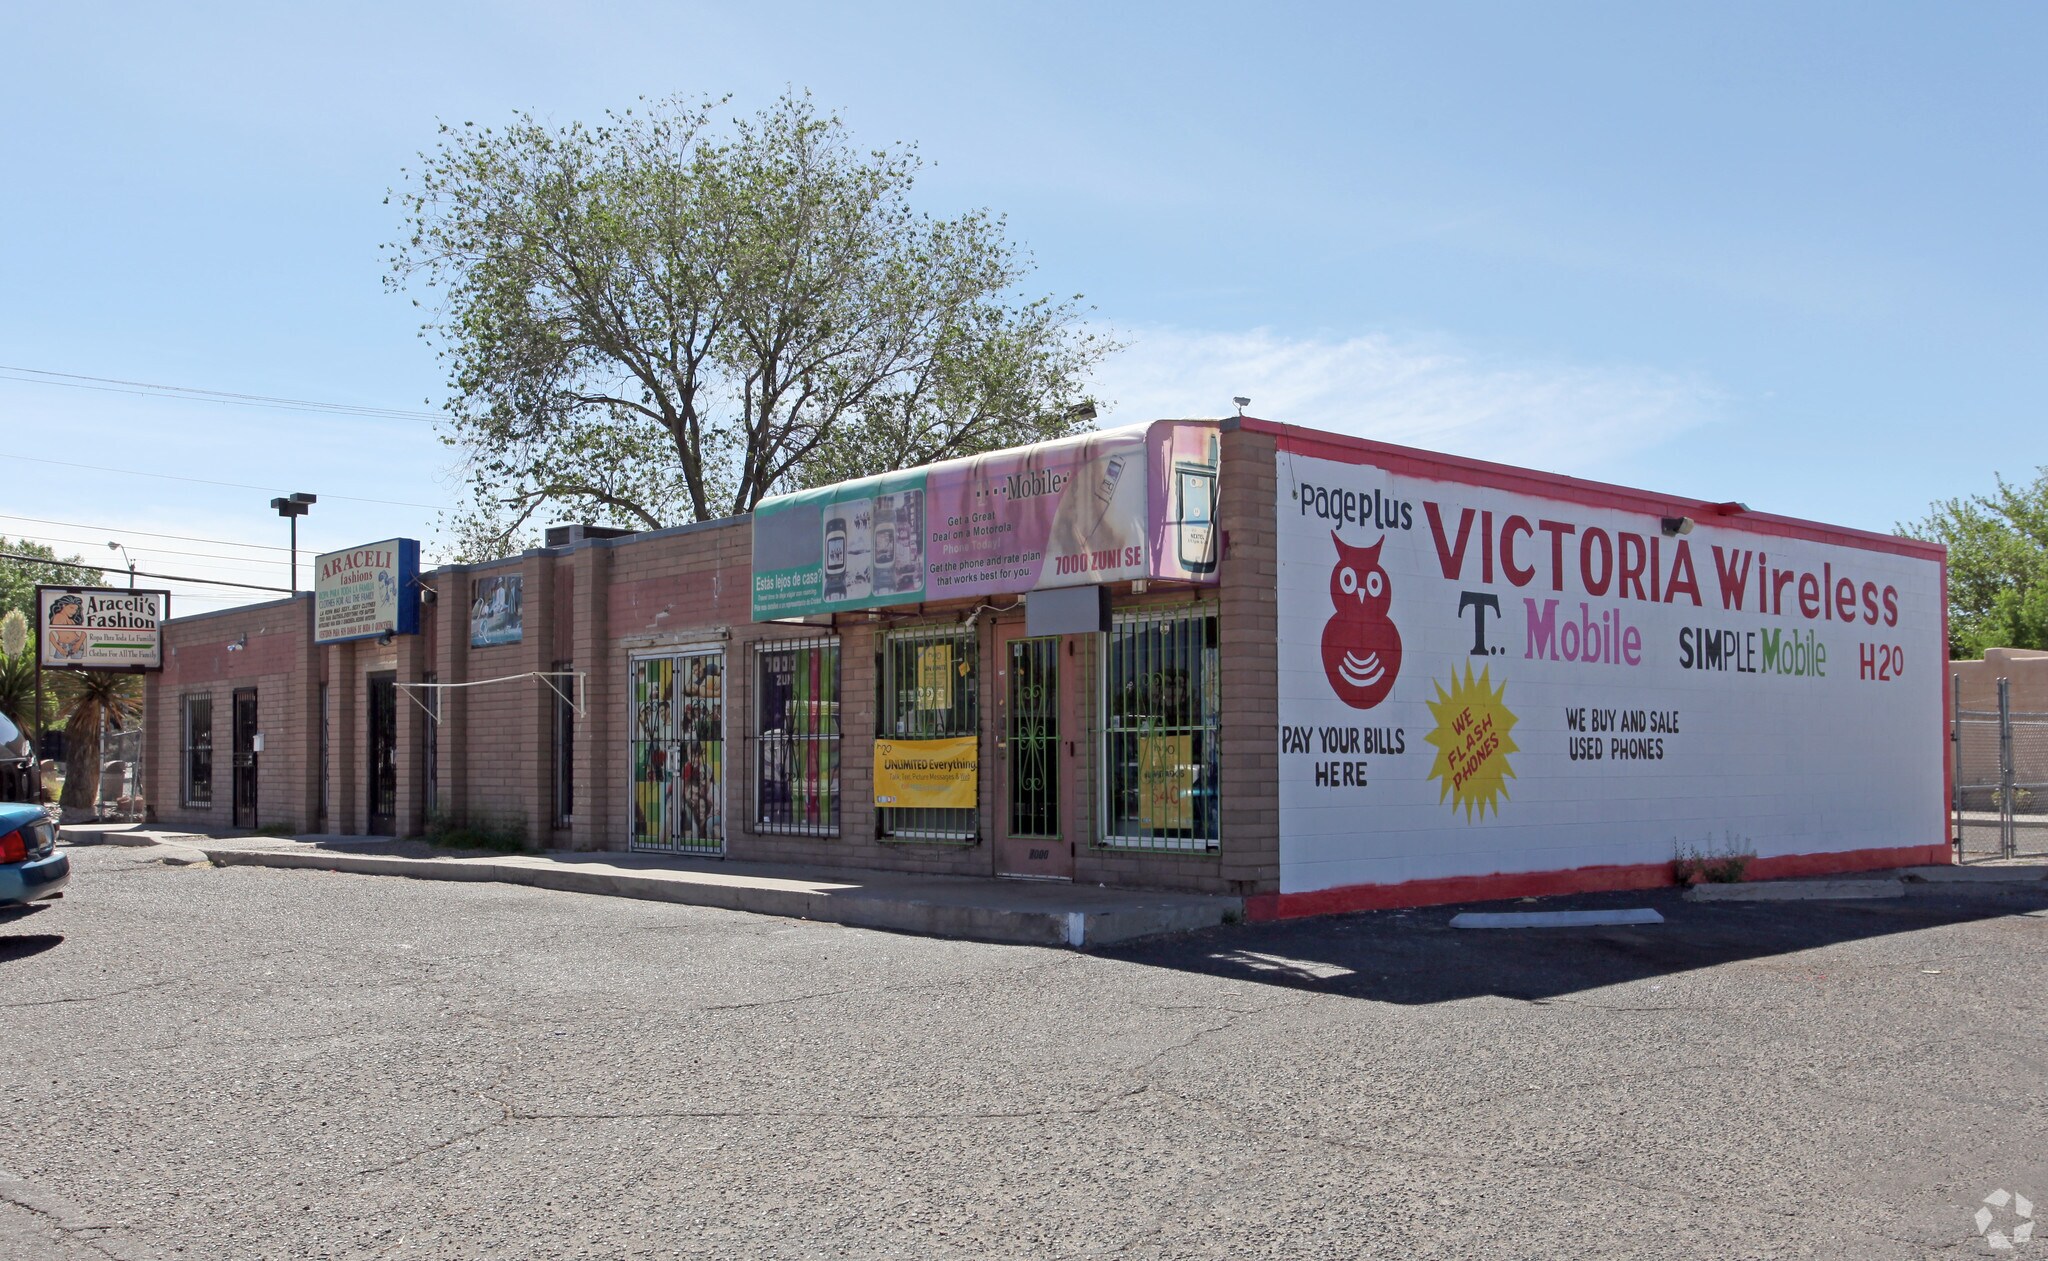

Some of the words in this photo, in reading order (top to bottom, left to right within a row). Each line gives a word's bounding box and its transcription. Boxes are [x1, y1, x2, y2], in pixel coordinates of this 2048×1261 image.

[948, 516, 962, 526] Get
[964, 516, 970, 524] a
[972, 511, 996, 522] Great
[932, 530, 950, 542] Deal
[953, 530, 964, 539] on
[974, 522, 1012, 536] Motorola
[943, 543, 969, 554] Phone
[321, 551, 392, 582] ARACELI
[930, 562, 944, 574] Get
[944, 561, 956, 570] the
[960, 558, 984, 570] phone
[986, 556, 1001, 566] and
[1004, 554, 1020, 564] rate
[1022, 551, 1040, 564] plan
[1056, 553, 1088, 576] 7000
[1091, 549, 1122, 571] ZUNI
[1125, 546, 1142, 566] SE
[1422, 501, 1702, 606] VICTORIA
[1711, 544, 1898, 627] Wireless
[340, 571, 372, 586] fashions
[756, 575, 774, 591] Estás
[776, 574, 790, 592] lejos
[792, 572, 800, 586] de
[802, 568, 822, 585] casa?
[937, 576, 952, 586] that
[954, 573, 978, 584] works
[980, 570, 998, 580] best
[1000, 568, 1012, 579] for
[1014, 567, 1032, 578] you.
[86, 596, 156, 616] Araceli's
[87, 612, 154, 628] Fashion
[90, 634, 102, 642] Ropa
[1523, 598, 1642, 666] Mobile
[1679, 626, 1756, 673] SIMPLE
[1760, 628, 1826, 677] Mobile
[138, 650, 156, 659] Family
[1452, 706, 1474, 736] WE
[1566, 707, 1586, 732] WE
[1592, 708, 1616, 732] BUY
[1620, 710, 1646, 732] AND
[1650, 710, 1680, 734] SALE
[1282, 726, 1314, 754] PAY
[1319, 726, 1360, 754] YOUR
[1364, 727, 1405, 754] BILLS
[1448, 713, 1492, 770] FLASH
[1570, 736, 1602, 760] USED
[1611, 738, 1664, 760] PHONES
[884, 760, 928, 770] UNLIMITED
[930, 758, 976, 772] Everything
[1453, 732, 1498, 792] PHONES
[930, 773, 954, 782] Messages
[1316, 762, 1368, 787] HERE
